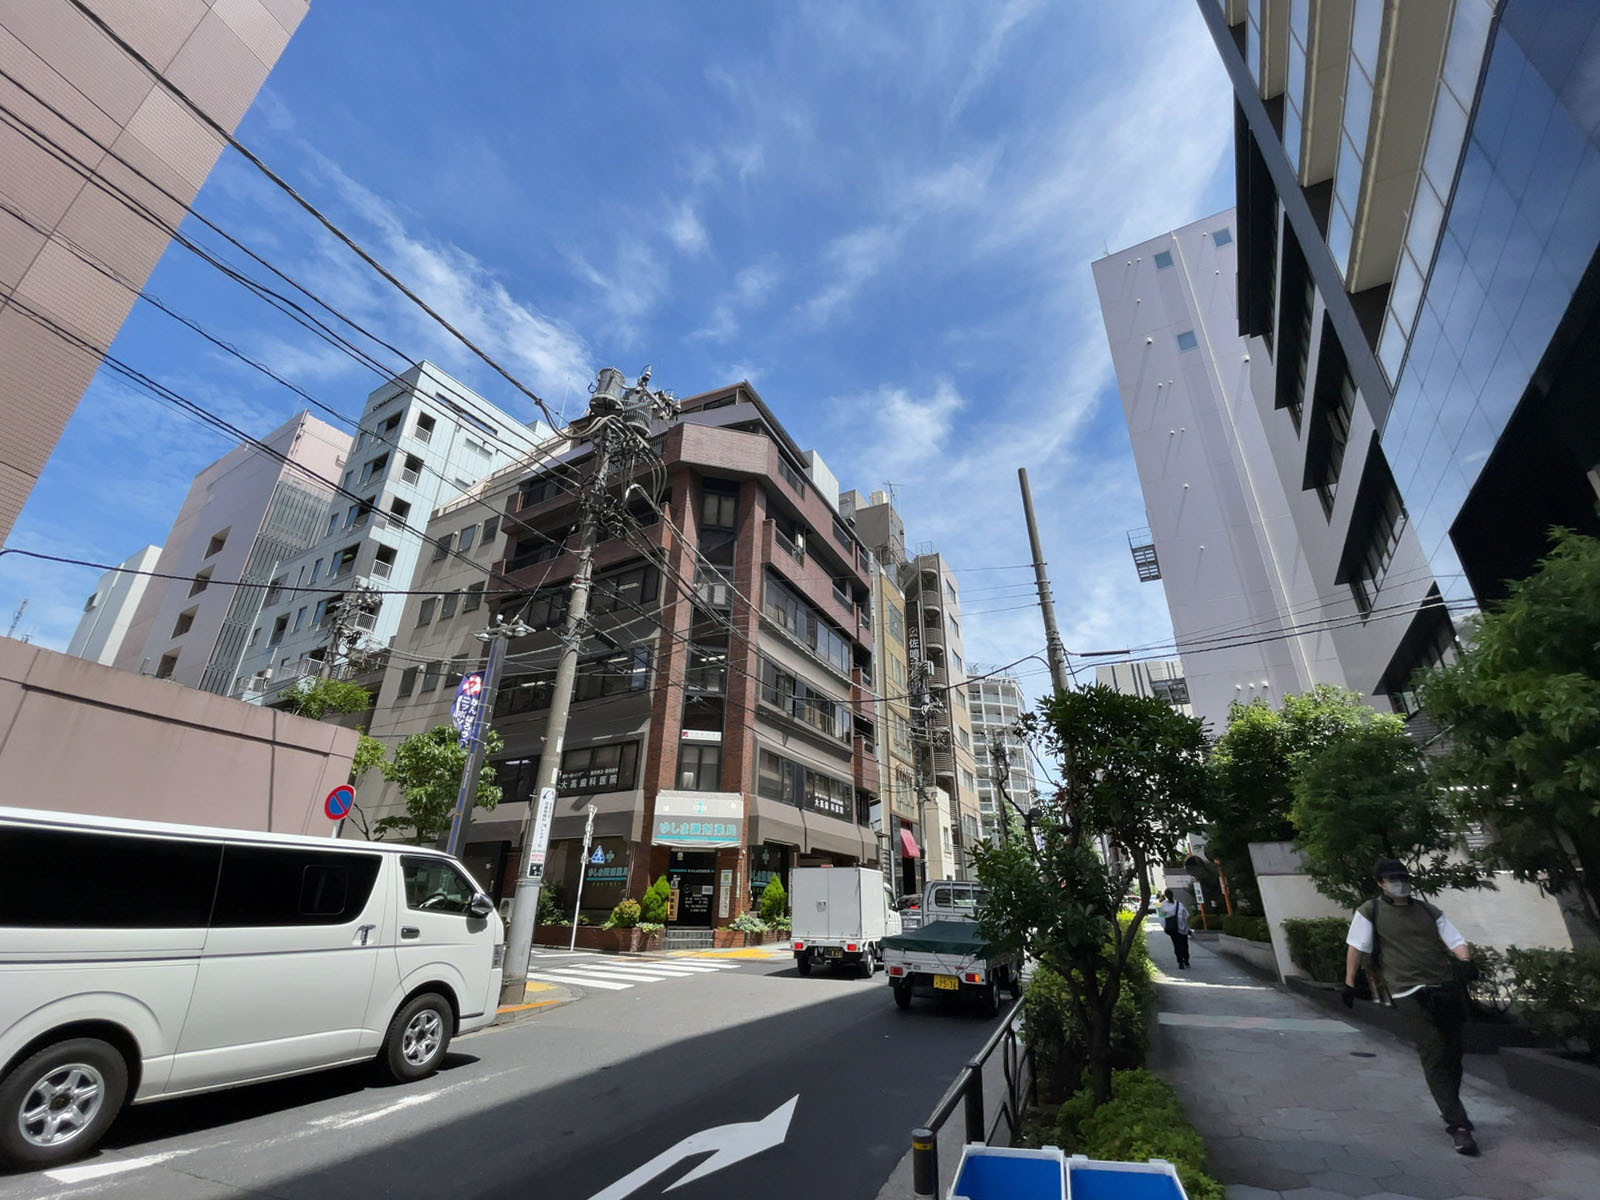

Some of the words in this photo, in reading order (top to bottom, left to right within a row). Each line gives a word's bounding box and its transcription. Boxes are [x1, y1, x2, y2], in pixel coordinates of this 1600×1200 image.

[659, 821, 738, 836] ゆしま調剤薬局
